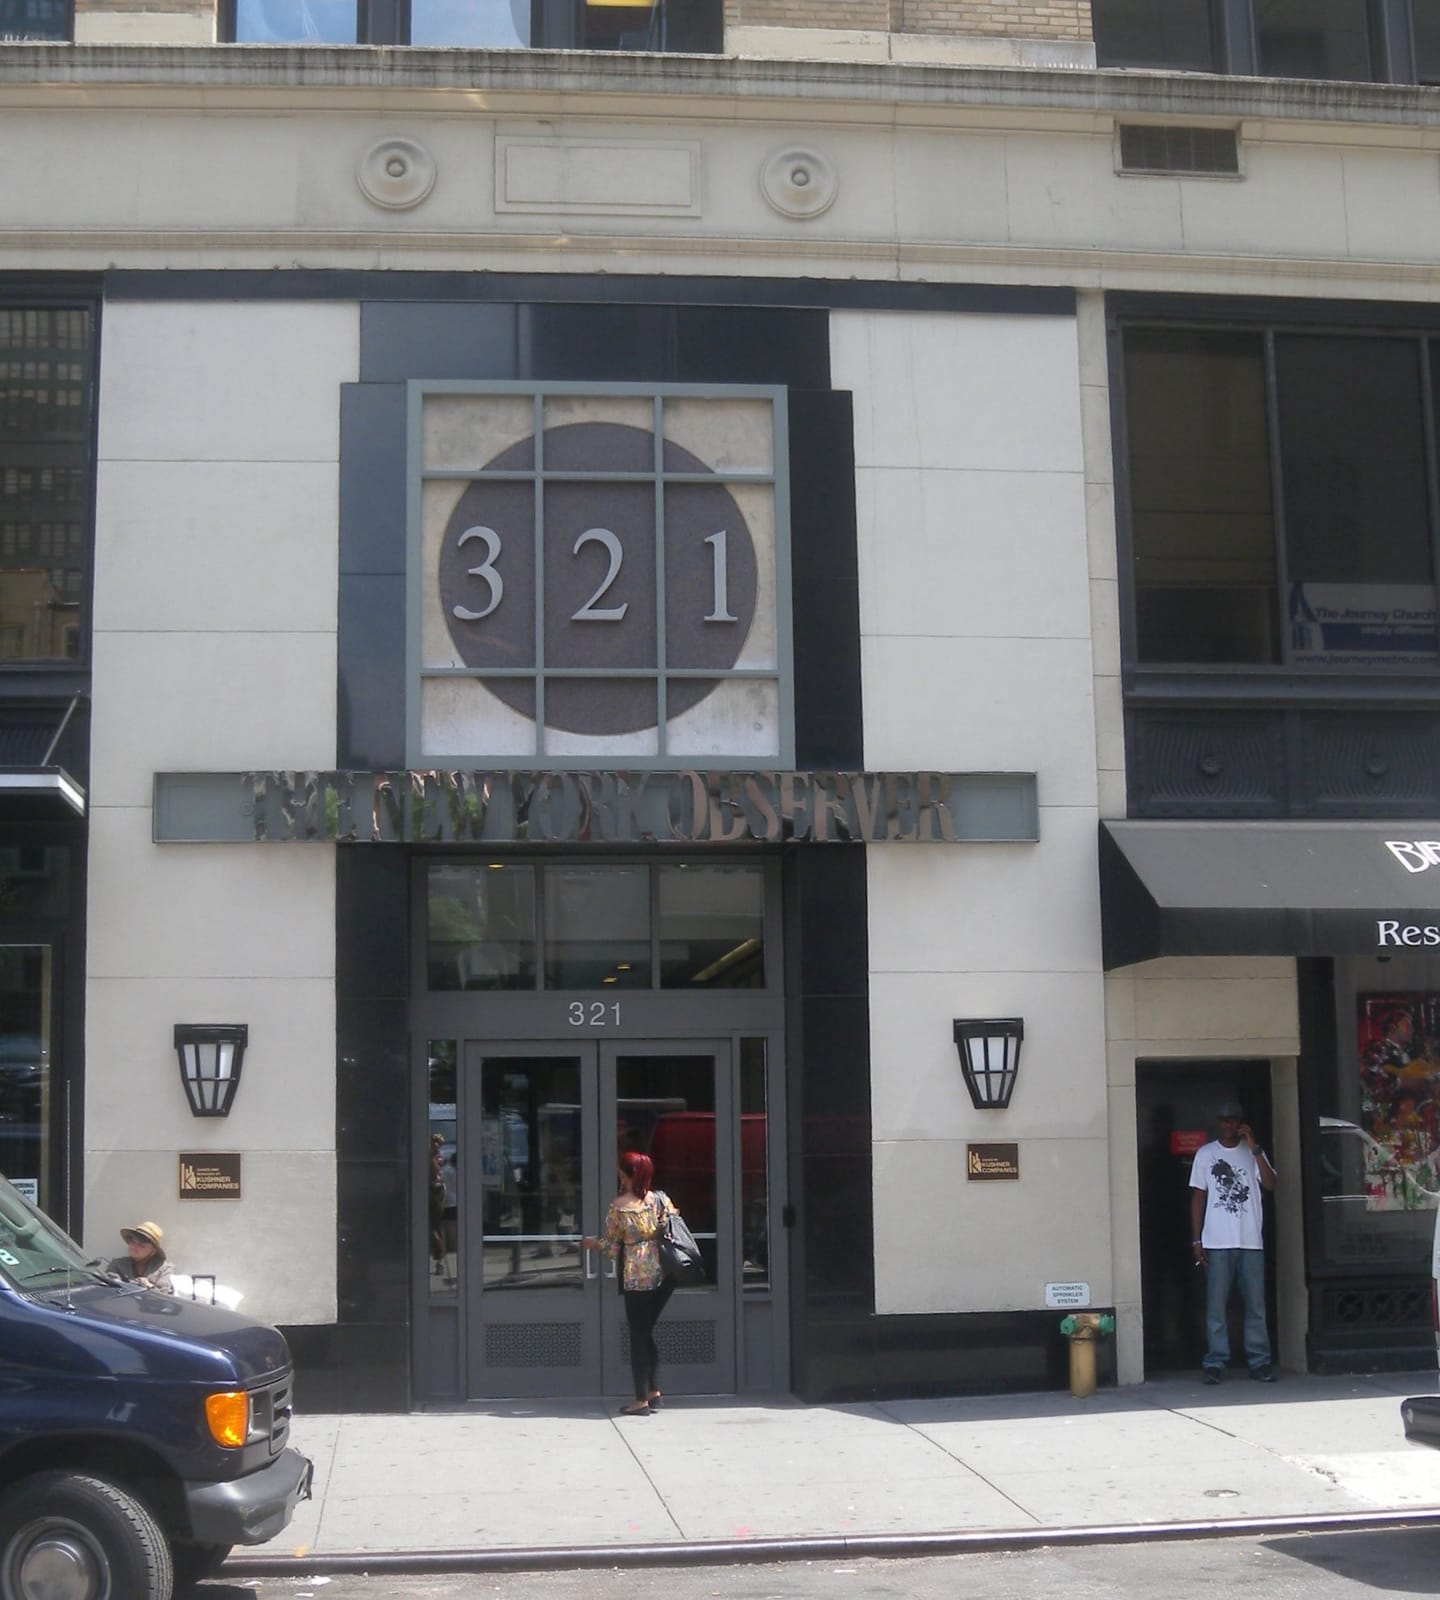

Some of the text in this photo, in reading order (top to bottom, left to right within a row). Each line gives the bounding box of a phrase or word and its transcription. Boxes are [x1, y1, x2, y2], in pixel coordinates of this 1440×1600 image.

[452, 525, 739, 622] 321
[1315, 607, 1437, 621] The Journey Church
[241, 770, 958, 841] THE NEW YORK OBSERVER
[568, 1001, 621, 1026] 321
[196, 1182, 240, 1190] COMPANIES
[197, 1175, 231, 1183] KUSHNER
